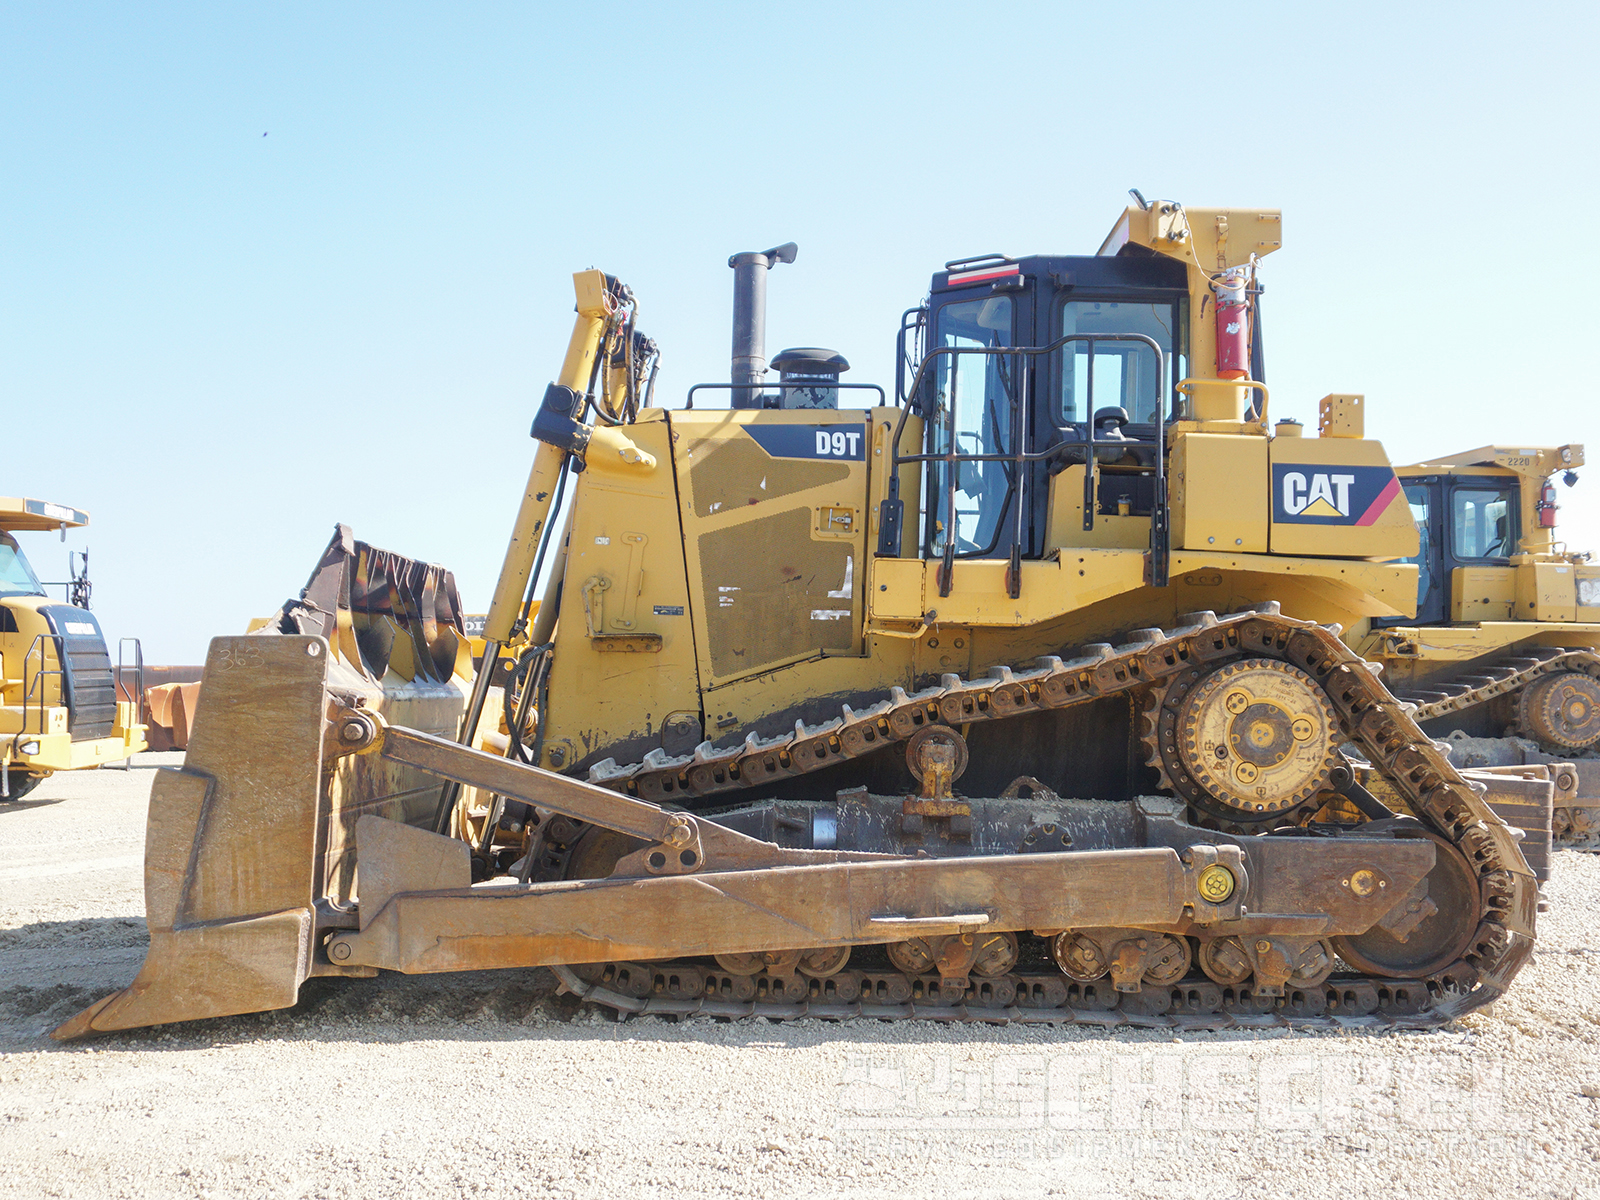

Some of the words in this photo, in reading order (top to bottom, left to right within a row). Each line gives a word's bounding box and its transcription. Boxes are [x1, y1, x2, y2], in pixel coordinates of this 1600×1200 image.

[816, 431, 860, 456] D9T
[1507, 457, 1530, 466] 2220
[1283, 471, 1355, 517] CAT
[218, 646, 265, 672] 363
